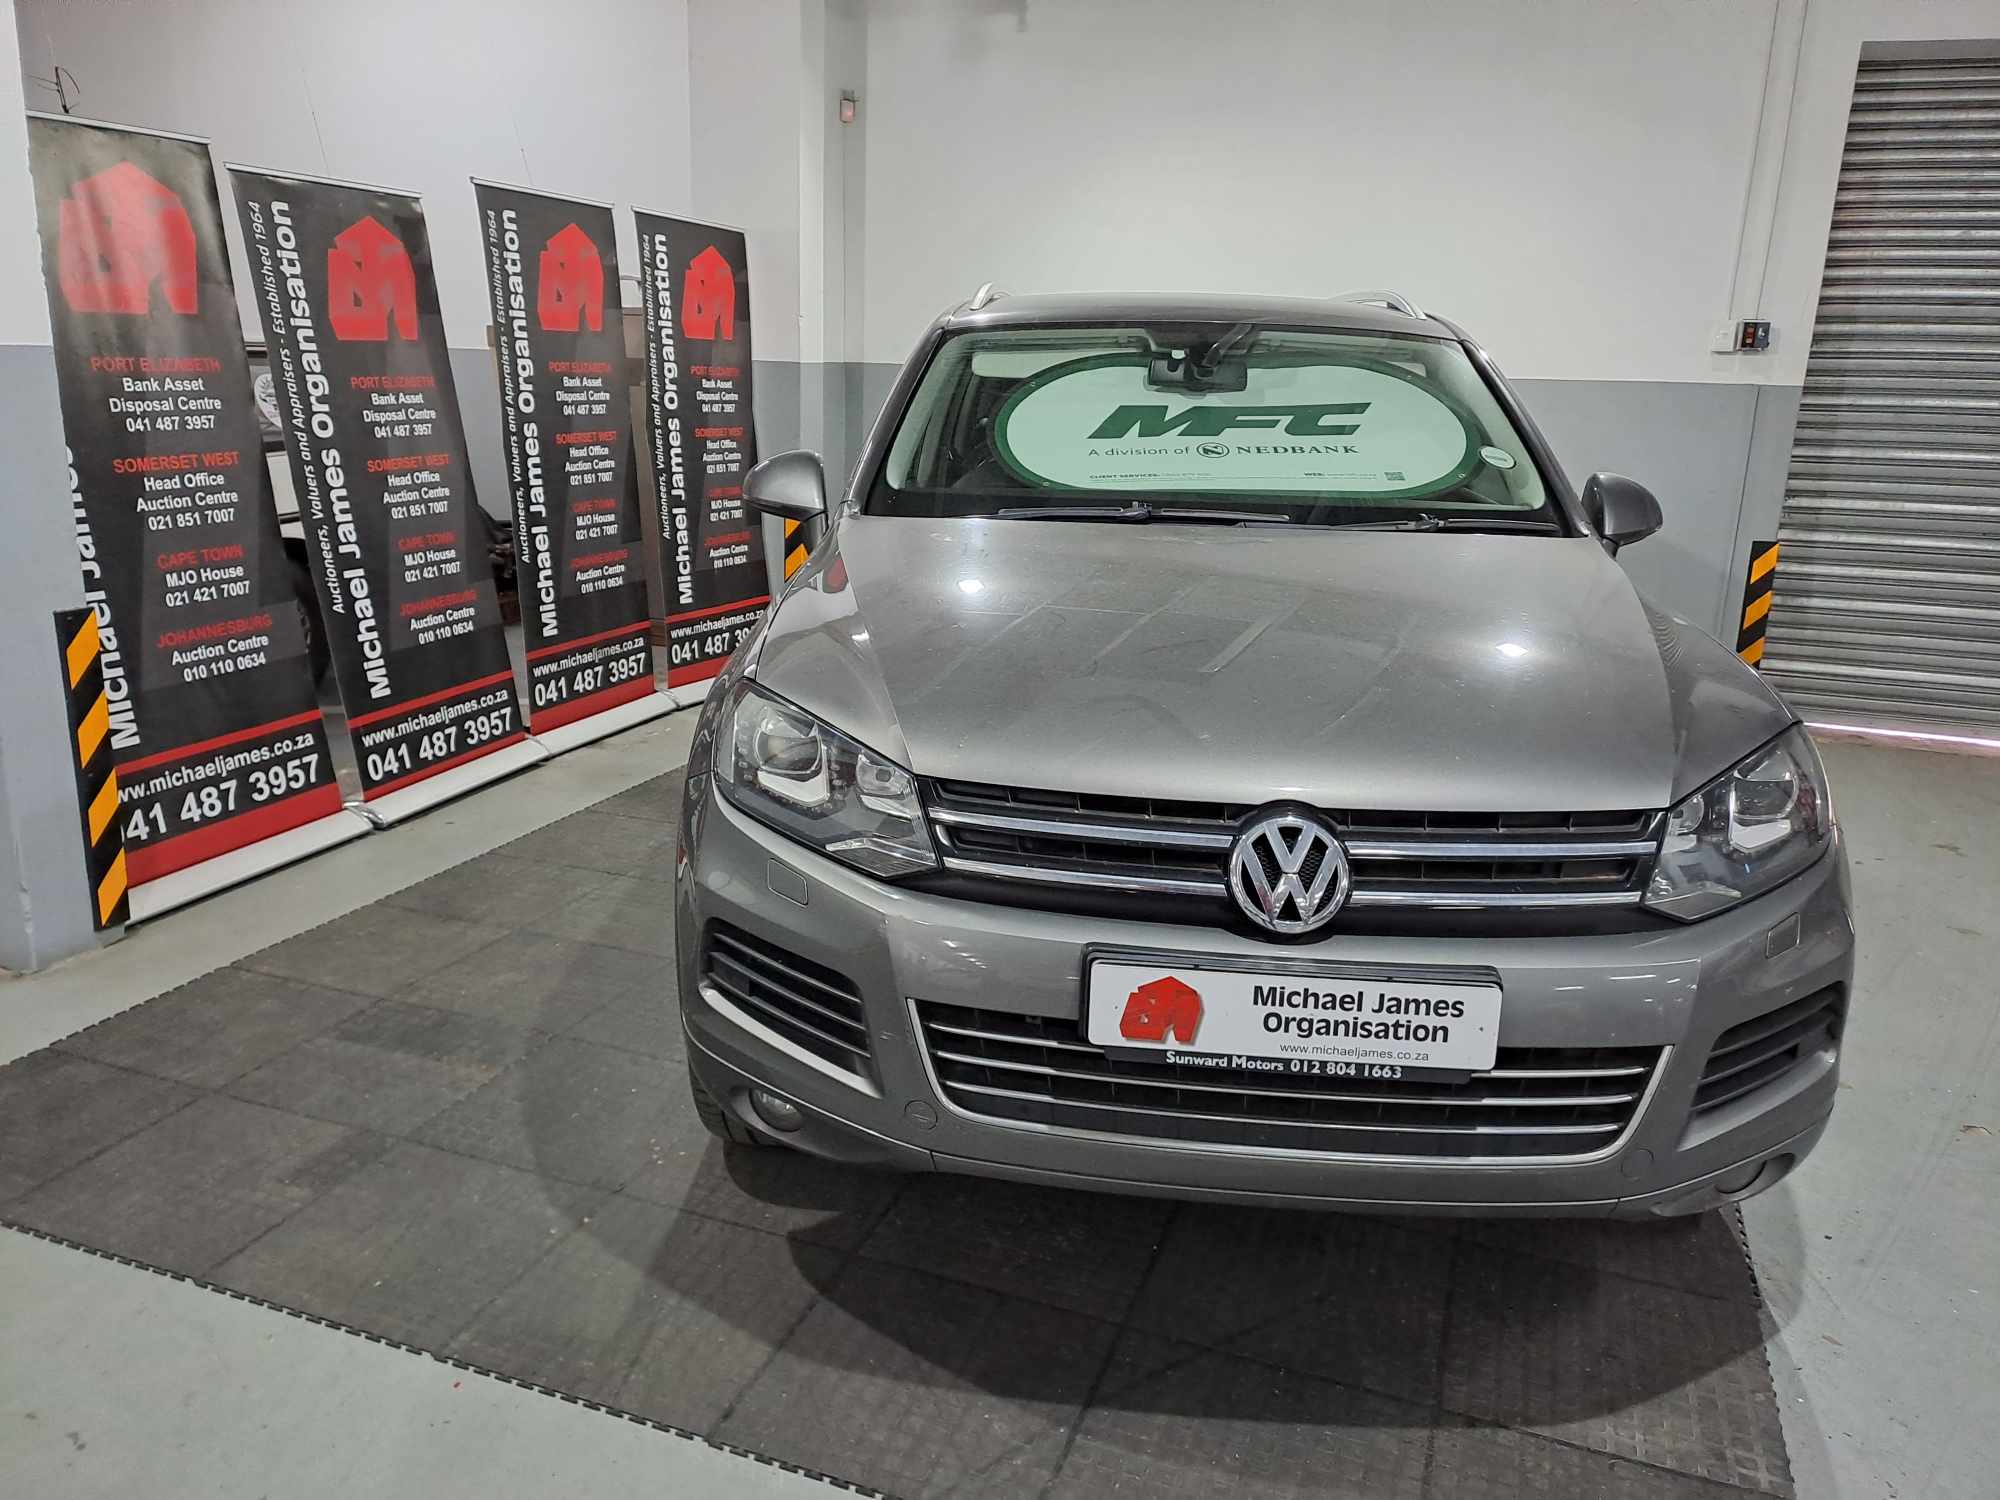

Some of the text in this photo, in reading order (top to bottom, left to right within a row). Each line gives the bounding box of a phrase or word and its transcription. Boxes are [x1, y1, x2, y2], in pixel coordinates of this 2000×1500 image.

[90, 357, 134, 373] PORT
[122, 377, 204, 393] Bank Asset
[351, 377, 380, 389] PORT
[487, 208, 531, 563] Auctioneers, Valuers and Appraisers Established 1964
[562, 376, 602, 387] Bank Asset
[108, 398, 222, 415] Disposal Centre
[248, 201, 345, 614] Auctioneers, Valuers and Appraisers Established 1964
[371, 392, 424, 405] Bank Asset
[556, 391, 587, 402] Disposal
[363, 409, 437, 424] Disposal Centre
[563, 405, 575, 415] 041
[651, 403, 661, 426] and
[654, 233, 693, 604] Michael James Organisation
[1087, 402, 1371, 439] MFC
[126, 415, 215, 433] 041 487 3957
[374, 424, 432, 438] 041 487 3957
[502, 209, 558, 638] Michael James Organisation
[271, 200, 392, 699] Michael James Organisation
[569, 446, 587, 458] Head
[655, 428, 665, 469] Valuers
[1088, 444, 1360, 457] A division of NEDBANK
[113, 451, 240, 474] SOMERSET WEST
[565, 459, 615, 473] Auction Centre
[143, 472, 225, 492] Head Office
[388, 471, 440, 487] Head Office
[570, 475, 582, 486] 021
[584, 473, 595, 484] 851
[136, 490, 239, 513] Auction Centre
[383, 486, 450, 504] Auction Centre
[659, 472, 672, 540] Auctioneers,
[148, 508, 235, 531] 021 851 7007
[391, 501, 448, 519] 021 851 7007
[589, 527, 600, 538] 421
[157, 544, 244, 570] CAPE TOWN
[404, 549, 456, 566] MJO House
[166, 564, 244, 588] MJO House
[405, 561, 461, 583] 021 421 7007
[576, 563, 625, 582] Auction Centre
[165, 581, 250, 607] 021 421 7007
[581, 582, 593, 594] 010
[595, 579, 606, 591] 110
[410, 606, 475, 631] Auction Centre
[418, 621, 474, 645] 010 110 0634
[171, 634, 269, 666] Auction Centre
[532, 637, 645, 678] www.michaeljames.co.za
[671, 639, 699, 664] 041
[704, 632, 729, 656] 487
[184, 652, 266, 682] 010 110 0634
[534, 652, 646, 706] 041 487 3957
[361, 689, 509, 748] www.michaeljames.co.za
[367, 706, 513, 782] 041 487 3957
[180, 779, 238, 823] 487
[248, 753, 319, 802] 3957
[1253, 985, 1465, 1018] Michael James
[1263, 1012, 1449, 1043] Organisation
[1280, 1043, 1429, 1062] www.michaeljames.co.za
[1165, 1050, 1402, 1079] Sunward Motors 012 804 1663
